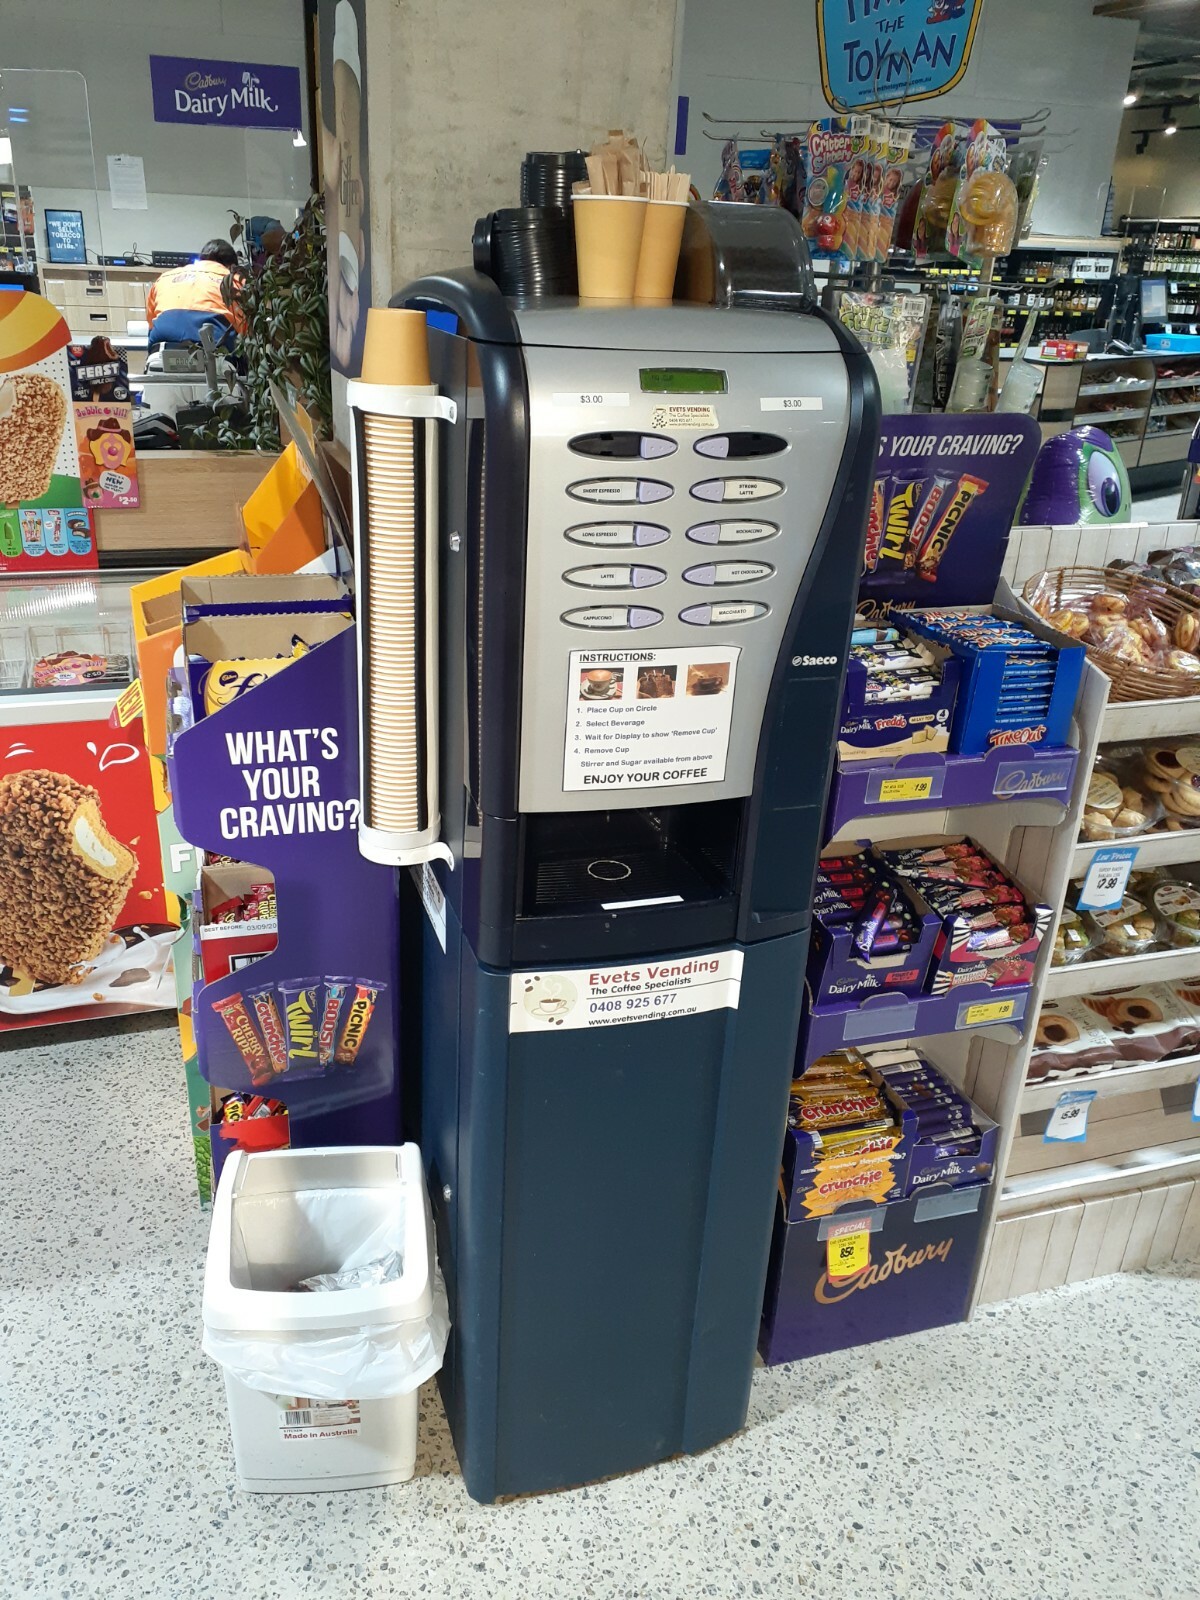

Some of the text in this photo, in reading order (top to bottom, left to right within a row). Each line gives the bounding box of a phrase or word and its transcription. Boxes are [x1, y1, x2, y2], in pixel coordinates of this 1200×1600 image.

[875, 15, 905, 34] THE
[843, 30, 957, 82] TOYMAN
[184, 72, 227, 91] Cadbury
[175, 86, 279, 117] Dairy Milk
[811, 132, 852, 157] Critter
[78, 363, 119, 379] FEAST
[580, 395, 603, 404] $3.00
[783, 399, 802, 408] $3.00
[890, 434, 1024, 457] YOUR CRAVING?
[909, 484, 945, 547] BOOST
[931, 489, 973, 554] PICNIC
[579, 652, 656, 663] INSTRUCTIONS:
[802, 655, 838, 667] Saeco
[609, 706, 624, 714] Cup
[636, 704, 657, 712] Circle
[611, 719, 645, 728] Beverage
[840, 719, 874, 734] Dairy Milk
[875, 716, 906, 731] Freddo
[225, 727, 339, 765] WHAT'S
[615, 731, 641, 741] Display
[615, 746, 630, 754] Cup
[581, 760, 604, 768] Stirrer
[605, 759, 620, 767] and
[621, 759, 642, 767] Sugar
[643, 756, 674, 765] available
[692, 753, 713, 761] above
[242, 766, 321, 801] YOUR
[583, 767, 708, 785] ENJOY YOUR COFFEE
[998, 768, 1065, 800] Cadbury
[219, 798, 361, 840] CRAVING?
[589, 958, 720, 986] Evets Vending
[591, 976, 692, 996] The Coffee Specialists
[829, 978, 881, 994] Dairy Milk
[589, 993, 677, 1014] 0408 925 677
[319, 999, 340, 1050] BOOST
[344, 1000, 367, 1048] PICNIC
[588, 1006, 697, 1026] www.evetsvending.com.au
[231, 1029, 252, 1057] RIPE
[236, 1015, 265, 1058] CHERRY
[801, 1096, 880, 1121] crunchie
[819, 1170, 882, 1195] crunchie
[912, 1164, 965, 1185] Dairy Milk
[834, 1221, 866, 1236] SPECIAL
[814, 1237, 954, 1304] Cadbury
[319, 1428, 358, 1437] Australia
